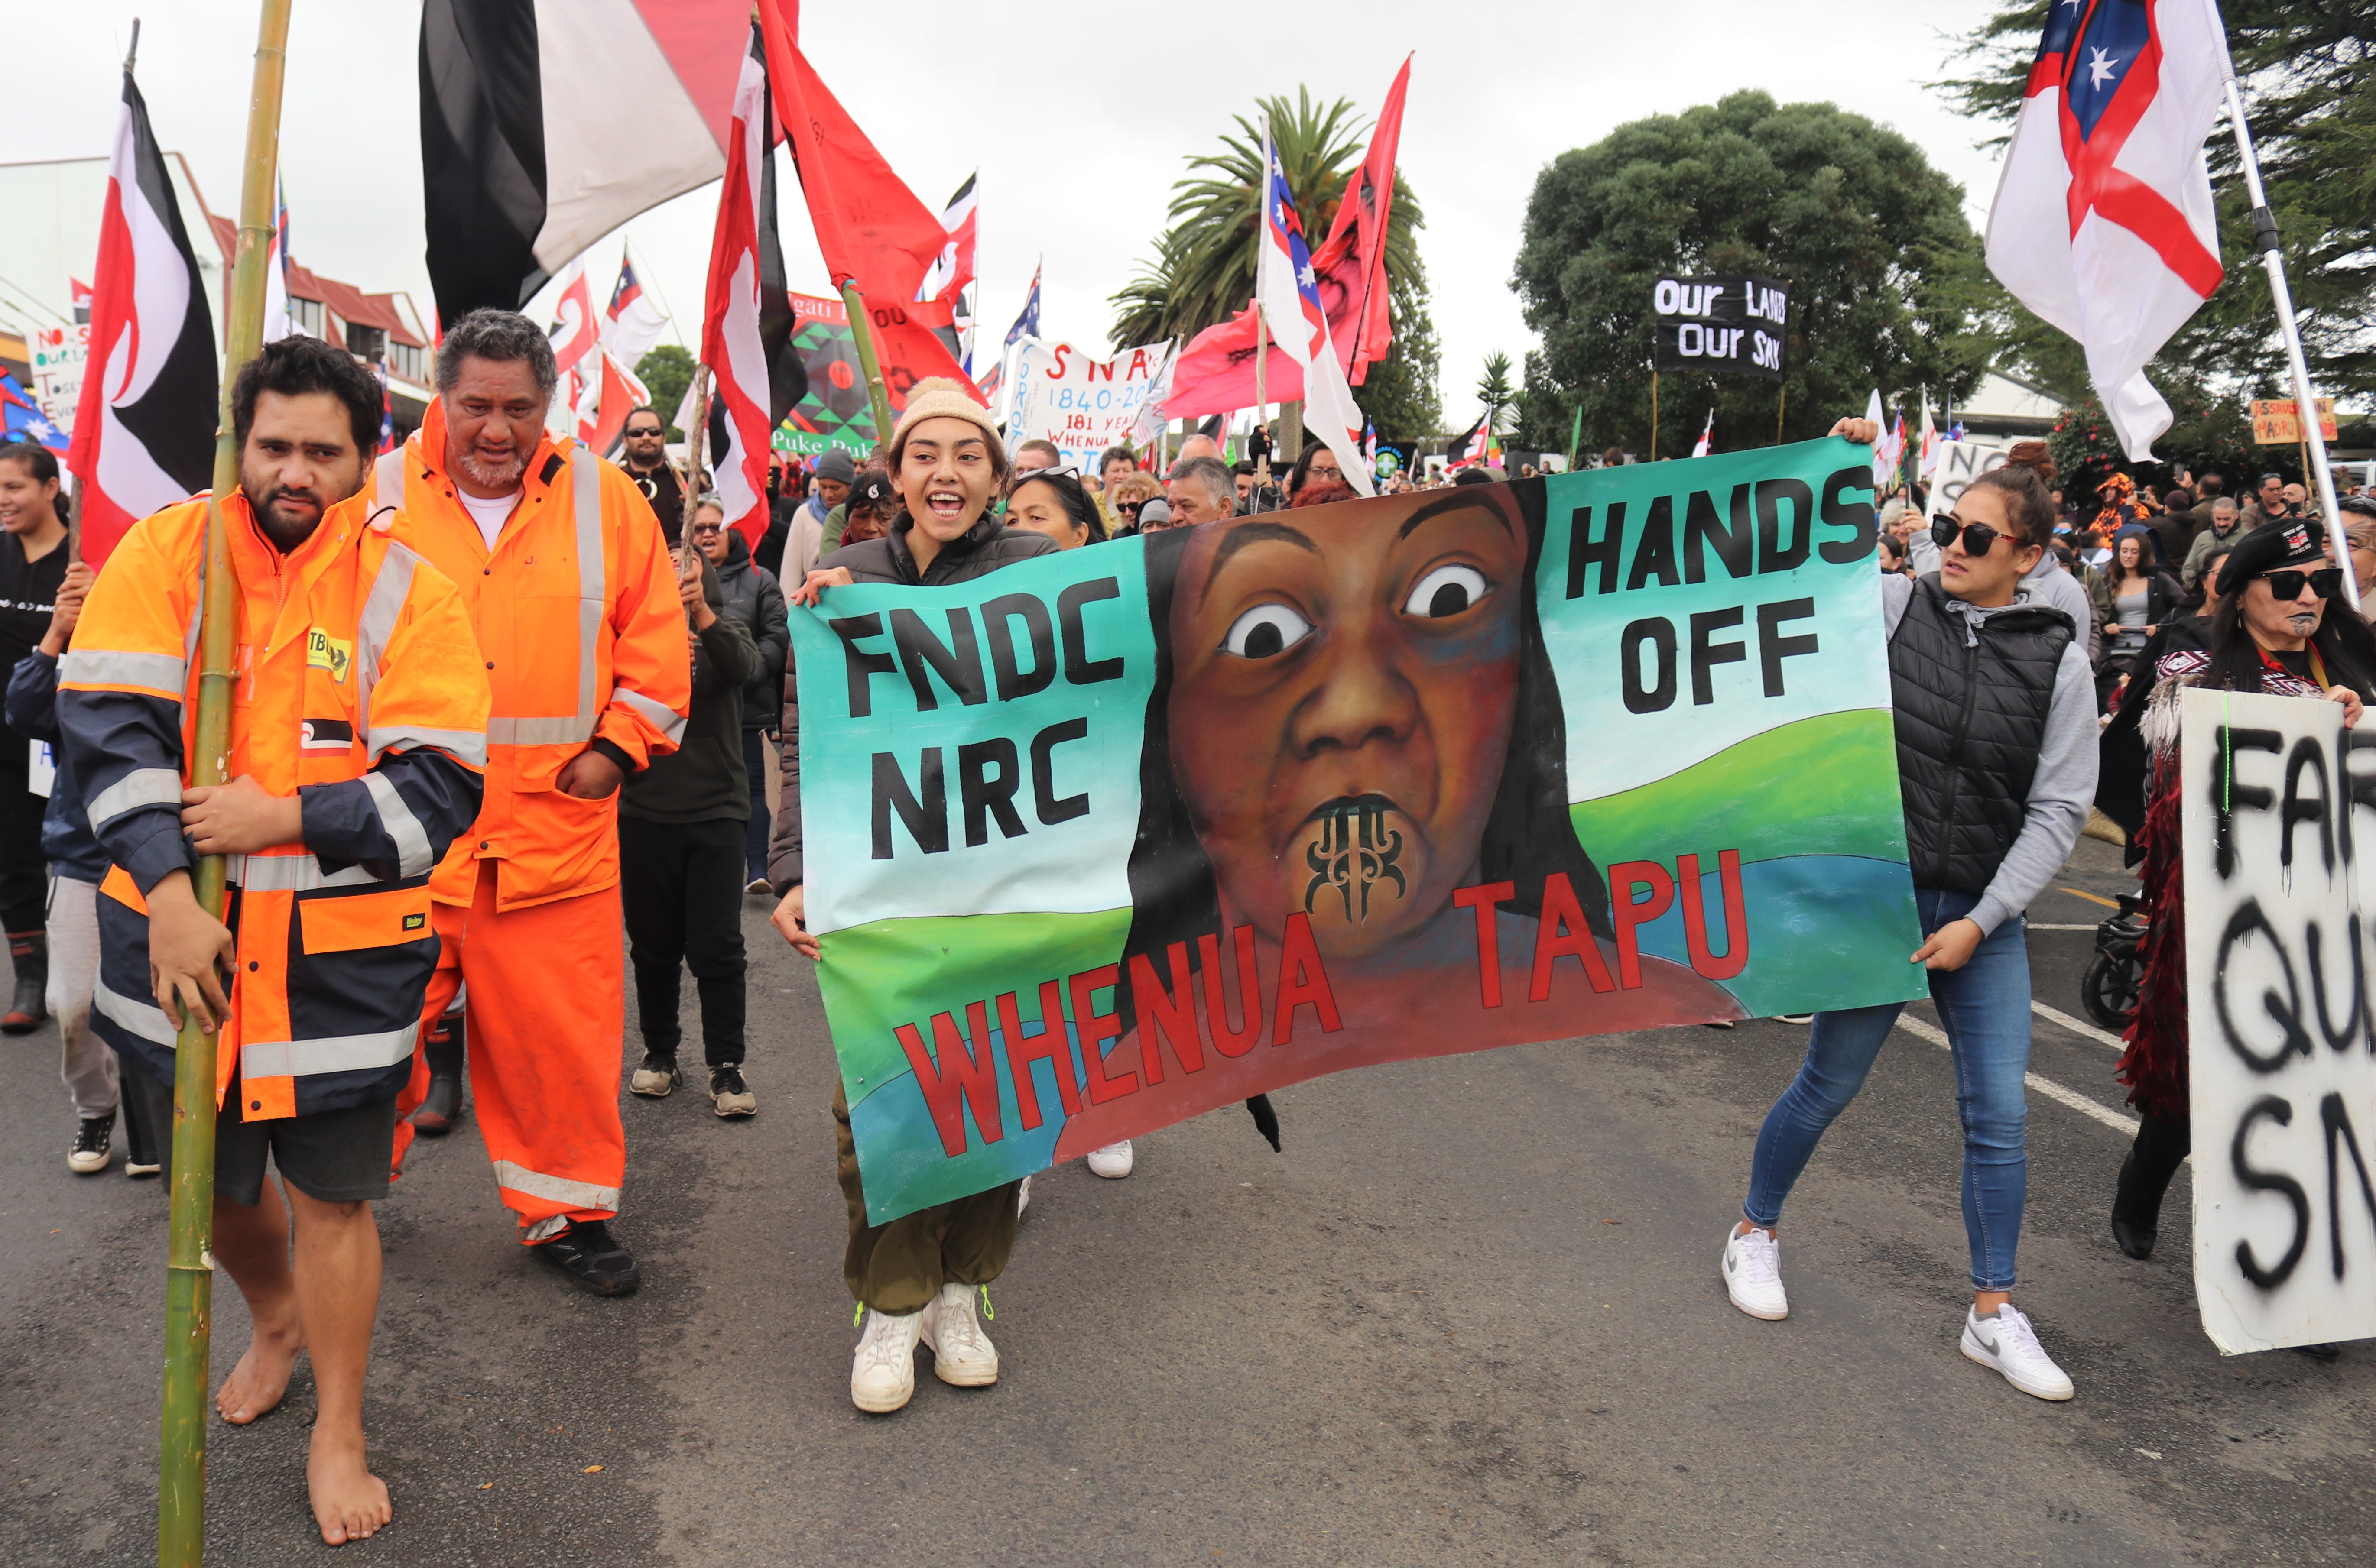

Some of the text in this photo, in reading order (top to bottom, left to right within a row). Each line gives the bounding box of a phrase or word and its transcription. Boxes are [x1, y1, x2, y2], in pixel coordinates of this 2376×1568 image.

[38, 329, 63, 349] NO
[789, 294, 831, 317] gāti
[868, 307, 906, 328] OU
[1746, 281, 1786, 325] LAND
[36, 350, 70, 366] OUR
[1752, 329, 1780, 371] SAY
[772, 430, 823, 454] Puke
[1047, 429, 1109, 447] WHENUA
[1066, 414, 1093, 431] 181
[1565, 465, 1879, 600] HANDS
[828, 576, 1124, 718] FNDC
[1621, 596, 1819, 714] OFF
[871, 717, 1090, 860] NRC
[2213, 726, 2376, 882] FAR
[1452, 848, 1749, 1009] TAPU
[2214, 895, 2376, 1076] QU
[893, 911, 1344, 1158] WHENUA
[2231, 1091, 2376, 1290] SN
